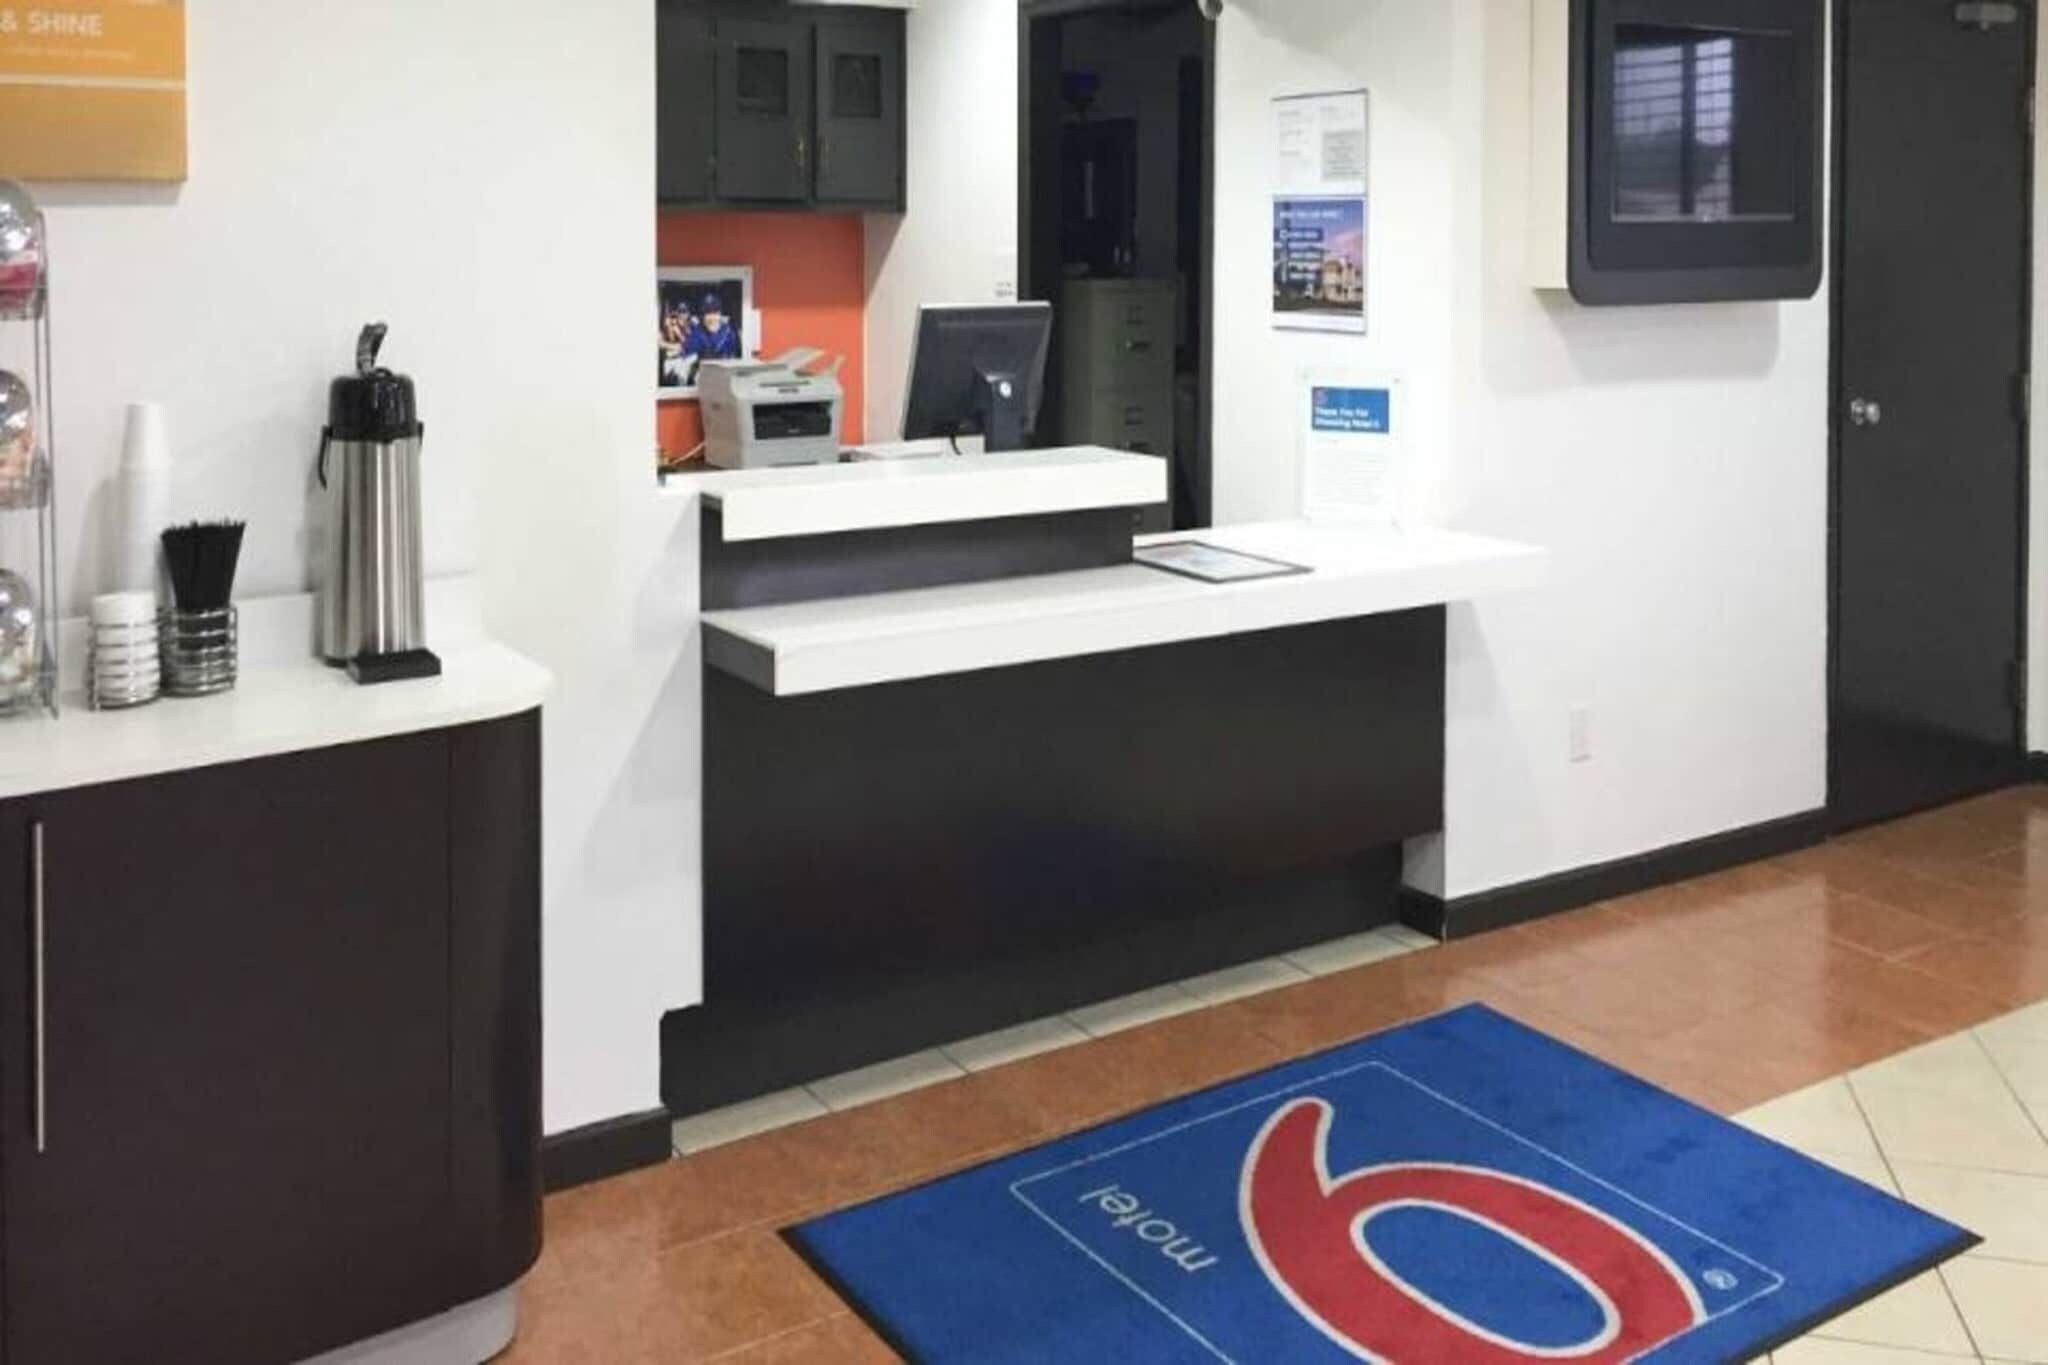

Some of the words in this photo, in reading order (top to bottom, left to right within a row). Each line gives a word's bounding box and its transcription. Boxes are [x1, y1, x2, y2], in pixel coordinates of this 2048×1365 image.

[29, 10, 104, 37] SHINE
[1078, 1184, 1219, 1272] motel
[1238, 1096, 1709, 1365] 6
